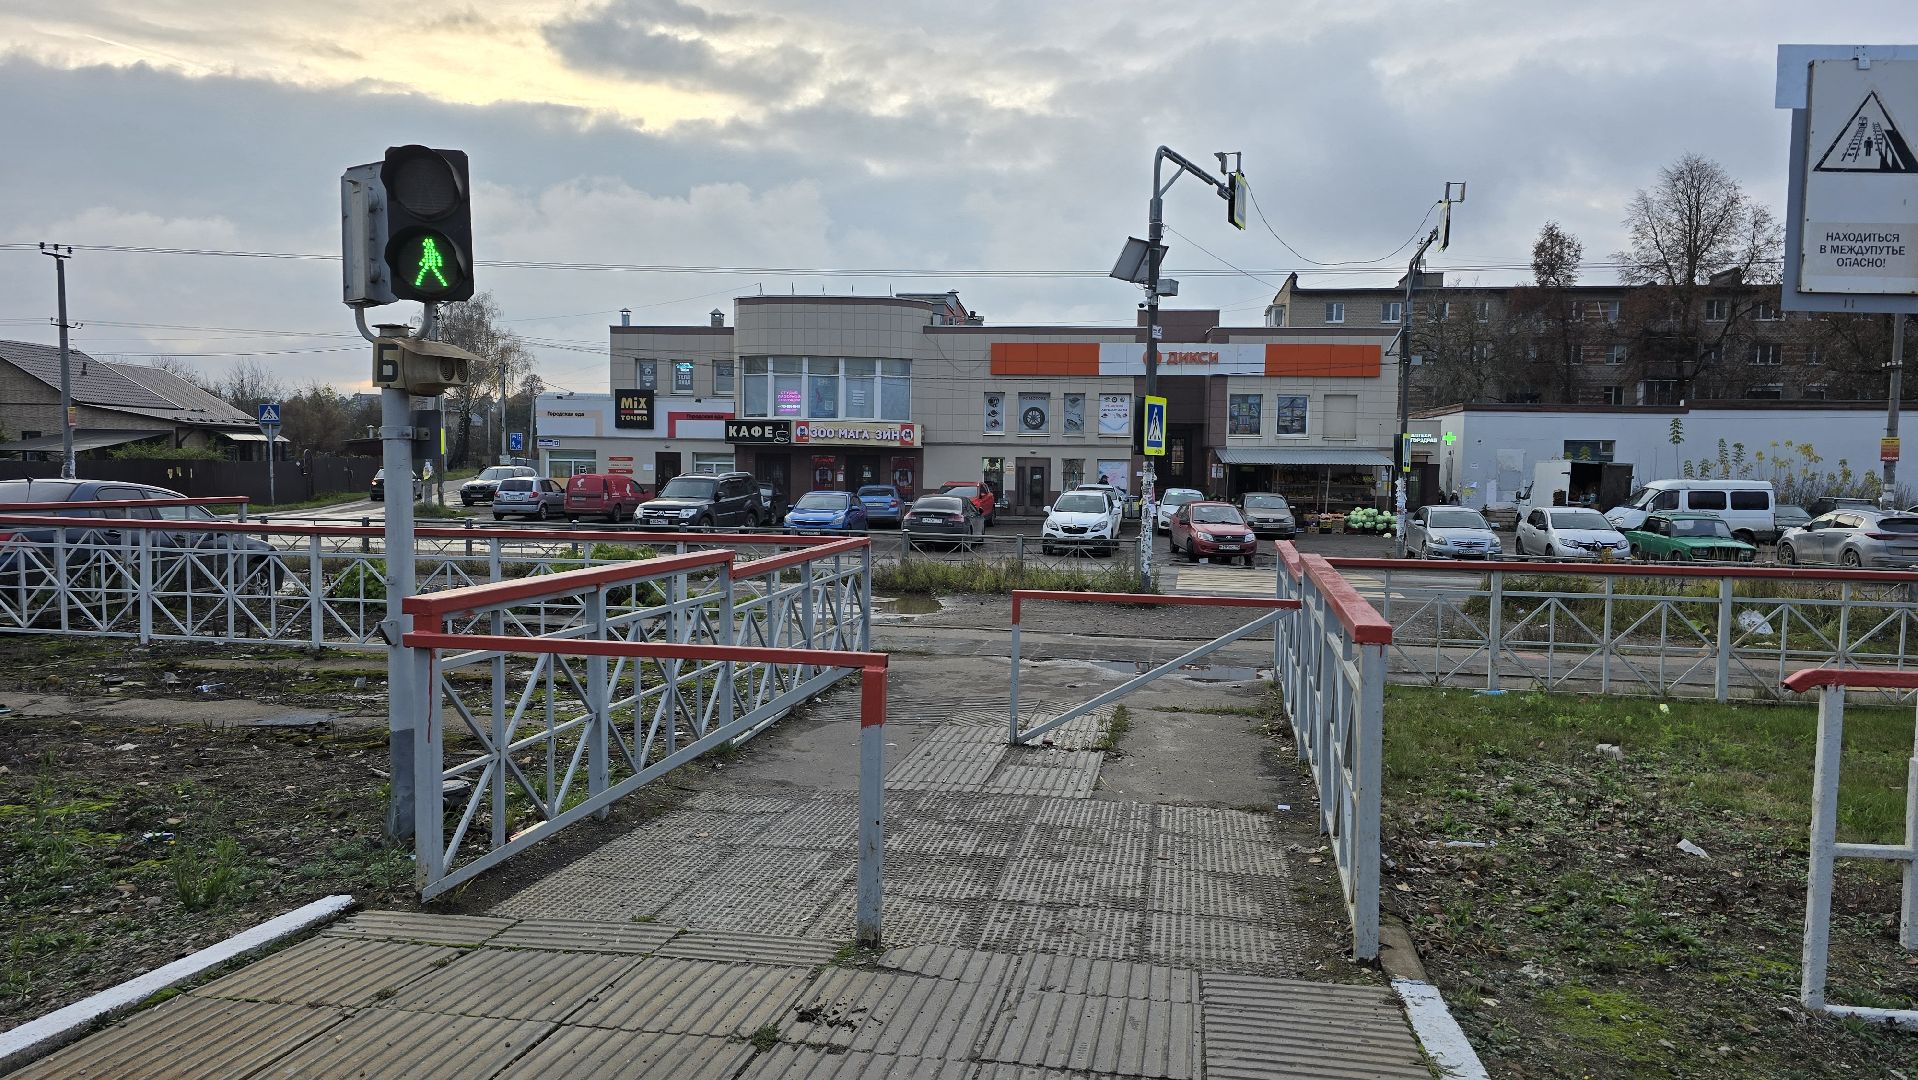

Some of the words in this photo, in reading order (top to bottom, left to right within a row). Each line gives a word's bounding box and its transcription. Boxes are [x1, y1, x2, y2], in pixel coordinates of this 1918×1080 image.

[1825, 232, 1900, 243] НАХОДИТЬСЯ
[1819, 244, 1827, 254] В
[1830, 245, 1906, 256] МЕЖДУПУТЬЕ
[1836, 257, 1886, 268] ОПАСНО!
[376, 343, 399, 383] Б
[1166, 351, 1219, 366] ДИКСИ
[728, 425, 774, 438] КАФЕ
[810, 427, 835, 438] ЗОО
[838, 427, 870, 440] МАГА
[875, 428, 899, 440] ЗИН
